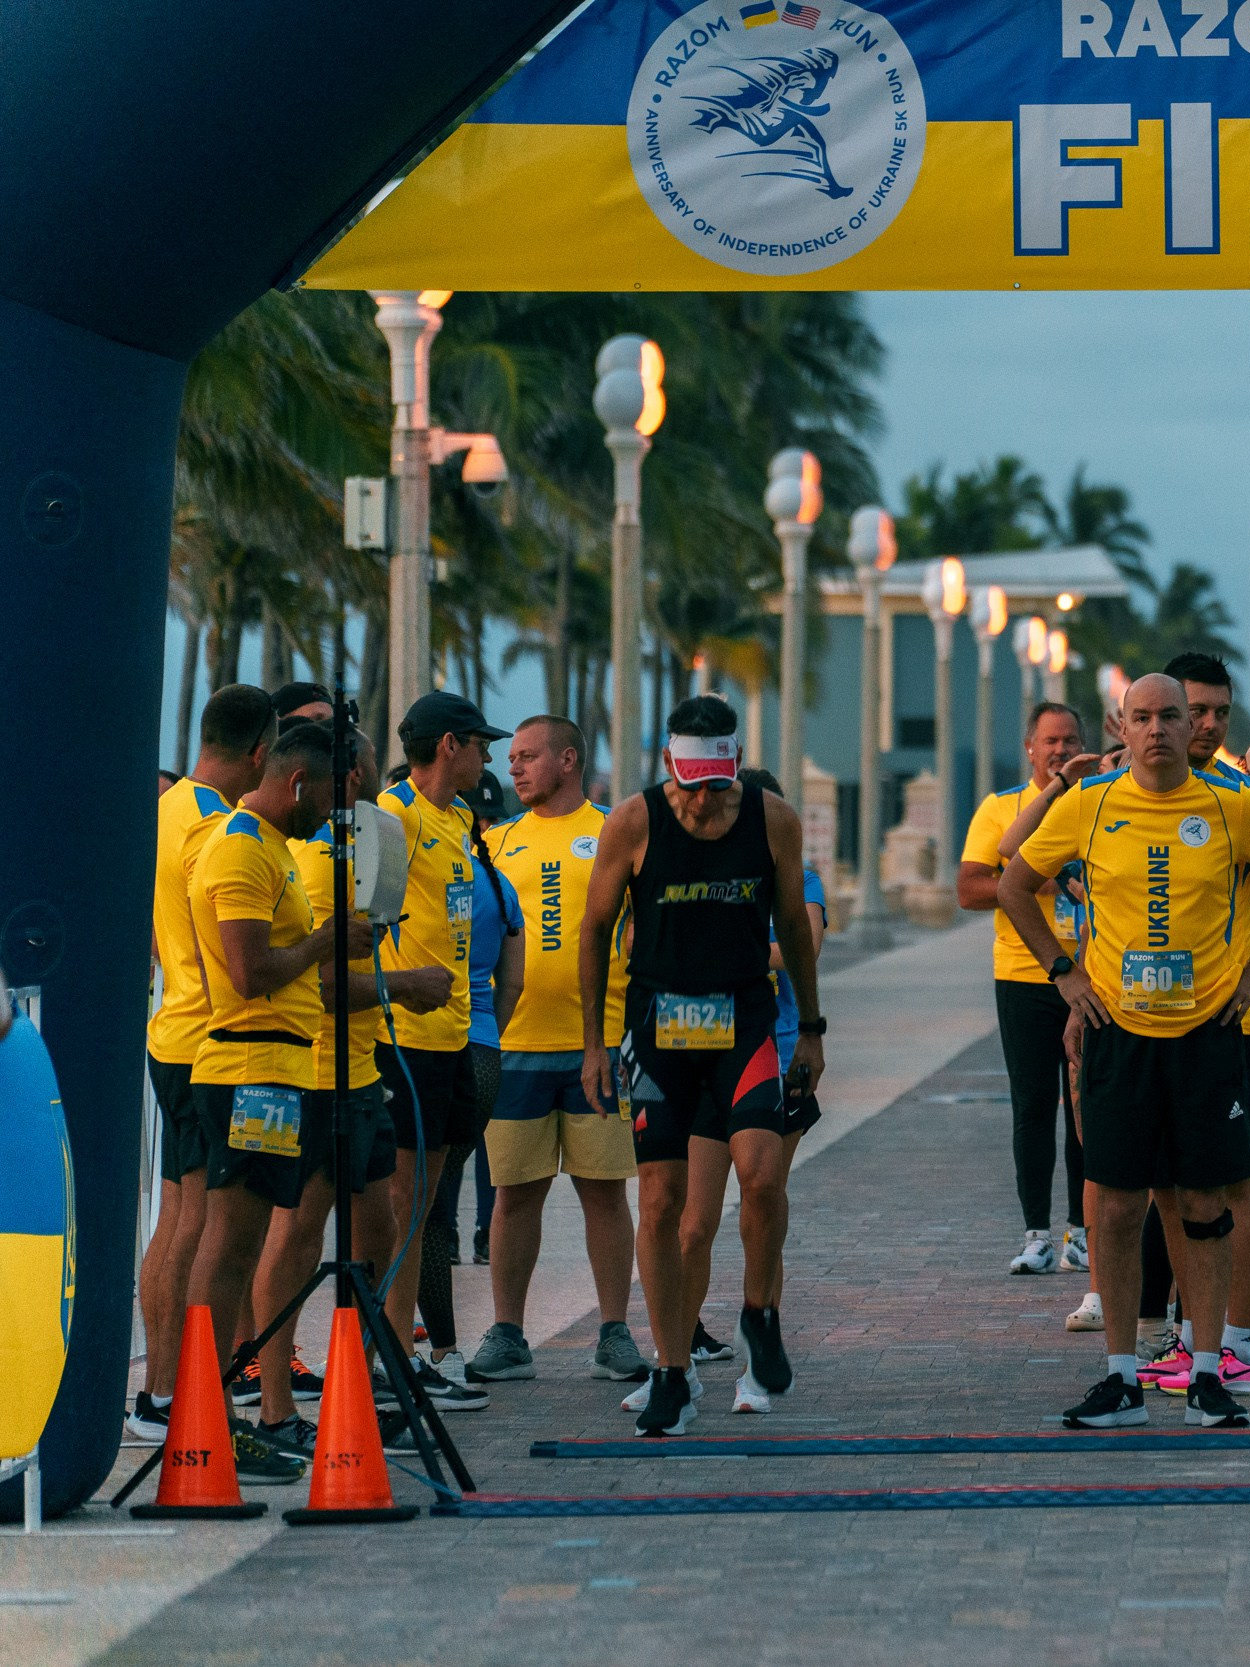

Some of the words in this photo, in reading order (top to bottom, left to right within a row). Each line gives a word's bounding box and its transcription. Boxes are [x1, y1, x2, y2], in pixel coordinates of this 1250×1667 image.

[655, 16, 731, 88] RAZOM
[829, 18, 879, 53] RUN
[885, 67, 906, 105] RUN
[894, 109, 908, 132] 5K
[645, 108, 694, 219] ANNIVERSARY
[868, 137, 907, 209] UKRAINE
[693, 218, 717, 237] OF
[848, 208, 870, 231] OF
[717, 226, 848, 257] INDEPENDENCE
[541, 860, 562, 952] UKRAINE
[1147, 845, 1170, 947] UKRAINE
[1129, 954, 1154, 962] RAZOM
[1141, 966, 1173, 993] 60
[673, 1003, 717, 1031] 162
[242, 1089, 274, 1098] RAZOM
[261, 1103, 286, 1133] 71
[171, 1449, 212, 1468] SST
